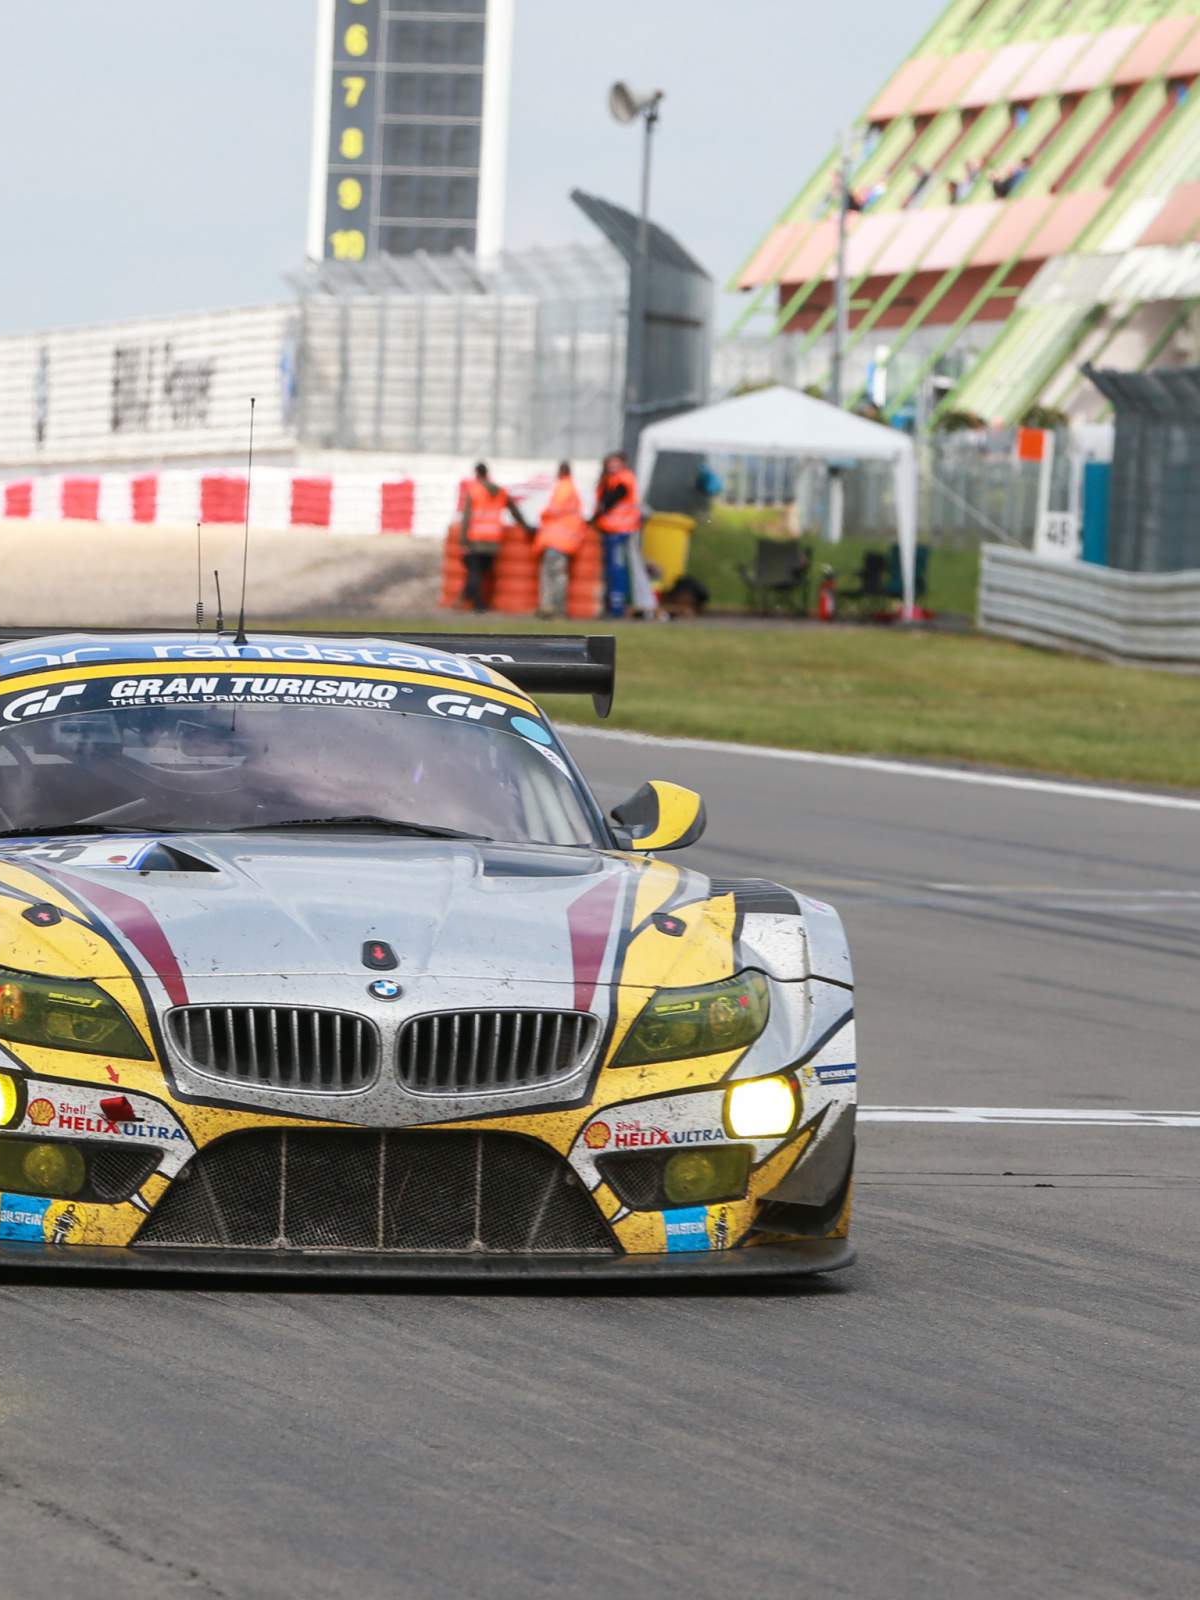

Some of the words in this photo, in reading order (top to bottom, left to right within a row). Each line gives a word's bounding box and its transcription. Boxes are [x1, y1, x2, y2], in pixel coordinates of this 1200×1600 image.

[344, 23, 368, 56] 6
[341, 76, 366, 108] 7
[340, 127, 364, 159] 8
[337, 178, 362, 210] 9
[329, 229, 365, 262] 10
[152, 643, 480, 680] randstad
[108, 697, 146, 706] THE
[150, 695, 199, 703] REAL
[203, 695, 280, 703] DRIVING
[283, 696, 392, 709] SIMULATOR
[110, 677, 219, 698] GRAN
[229, 677, 399, 701] TURISMO
[59, 1103, 87, 1114] Shell
[58, 1115, 121, 1135] HELIX
[123, 1123, 185, 1140] ULTRA
[615, 1120, 641, 1132] Shell
[615, 1129, 671, 1148] HELIX
[672, 1128, 725, 1144] ULTRA
